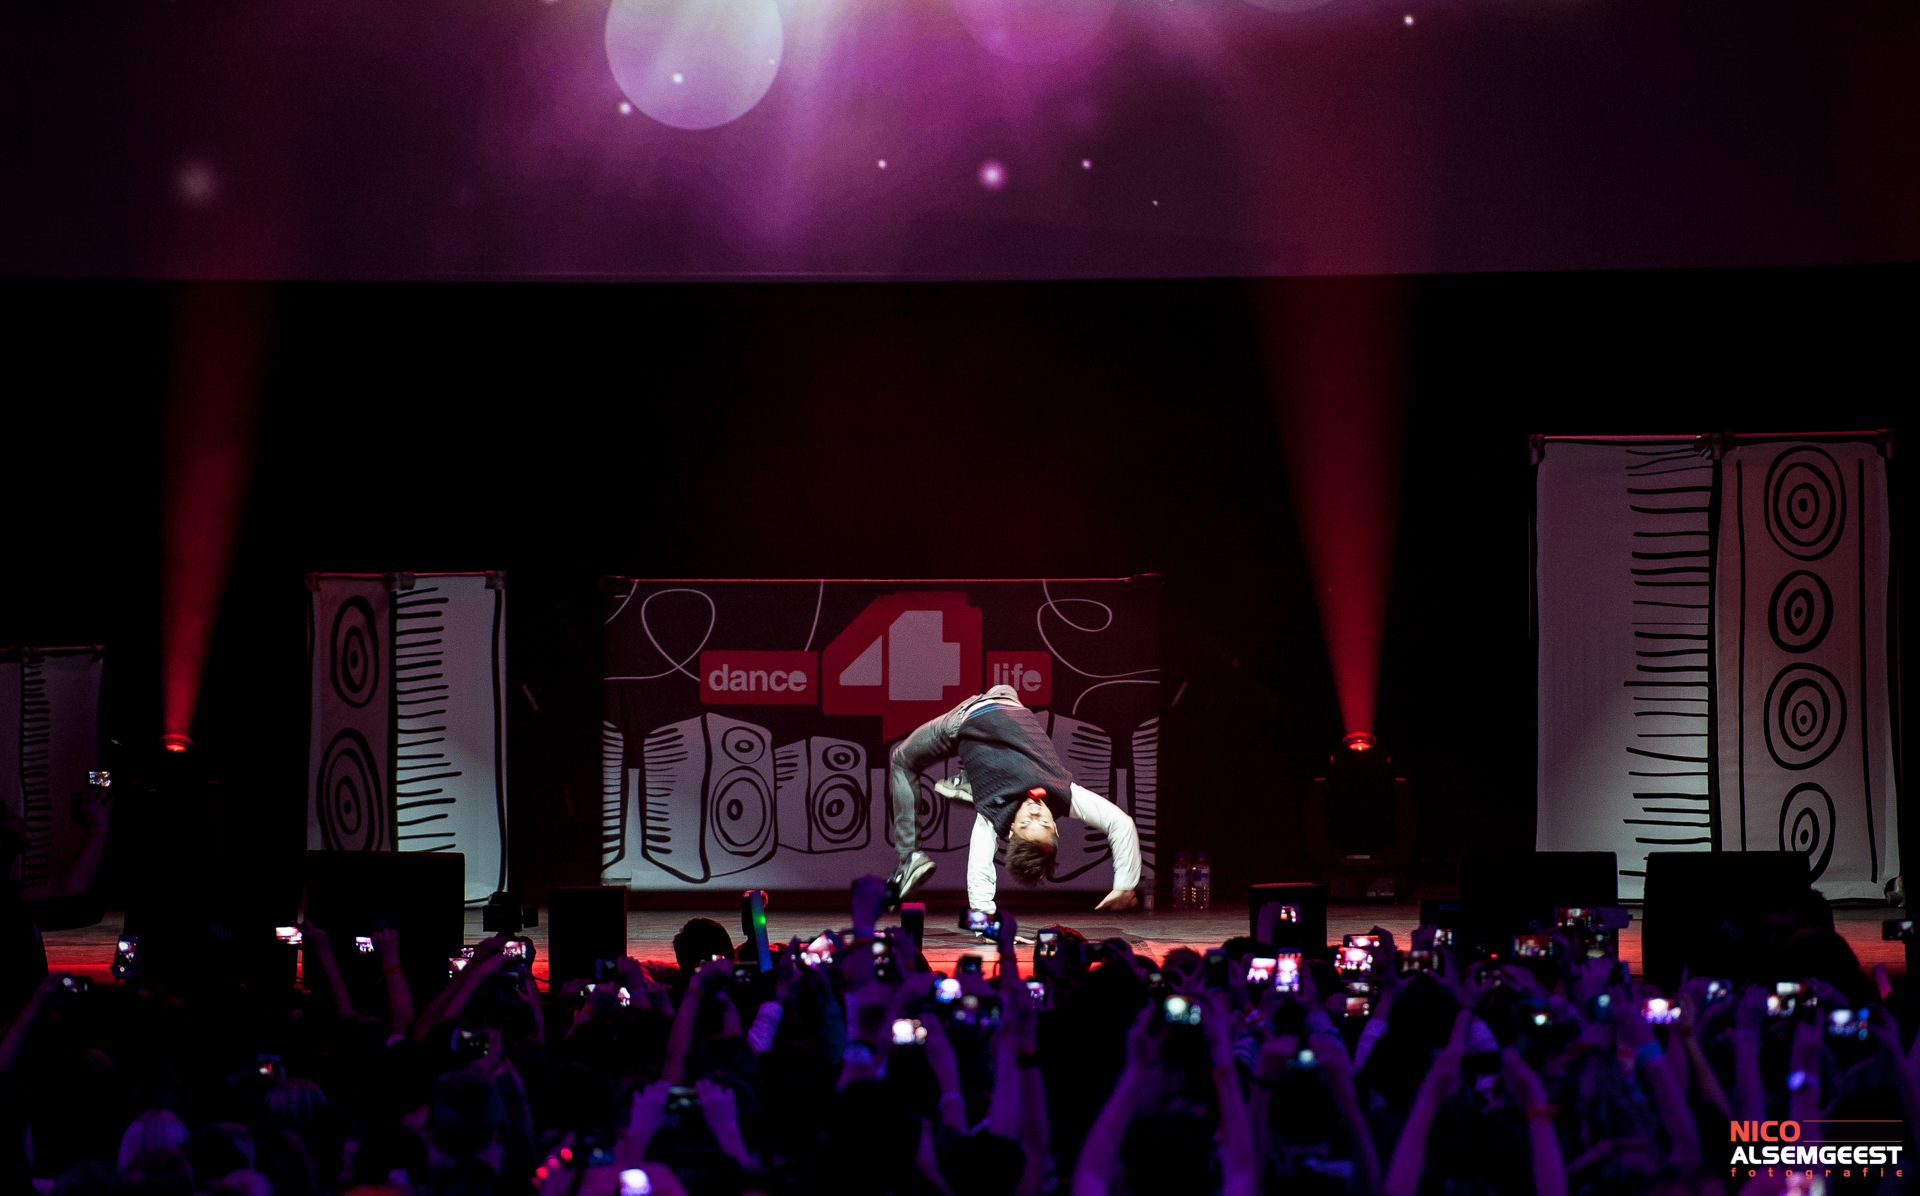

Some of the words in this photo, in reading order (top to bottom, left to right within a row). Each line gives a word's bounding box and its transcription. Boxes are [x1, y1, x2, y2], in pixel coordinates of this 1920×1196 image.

[708, 663, 807, 692] dance
[839, 610, 961, 701] 4
[993, 662, 1042, 692] life
